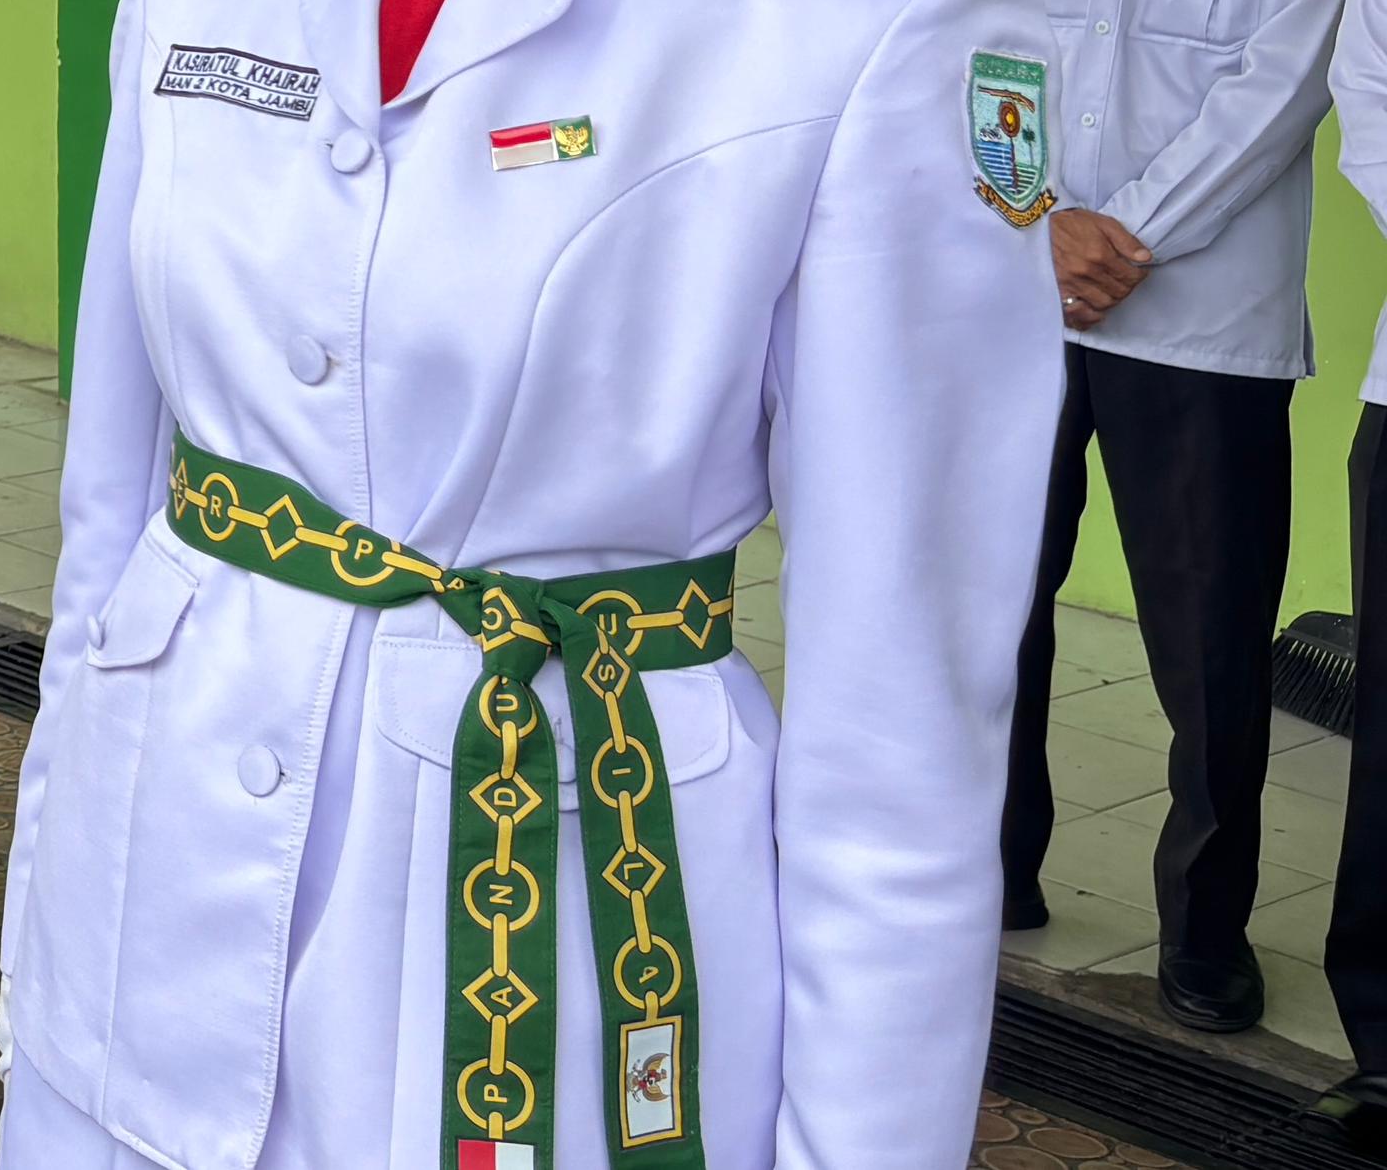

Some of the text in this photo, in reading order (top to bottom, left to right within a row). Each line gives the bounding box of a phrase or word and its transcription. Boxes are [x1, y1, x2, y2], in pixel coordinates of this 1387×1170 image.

[165, 75, 311, 113] MAN 2 KOTA JAMBI
